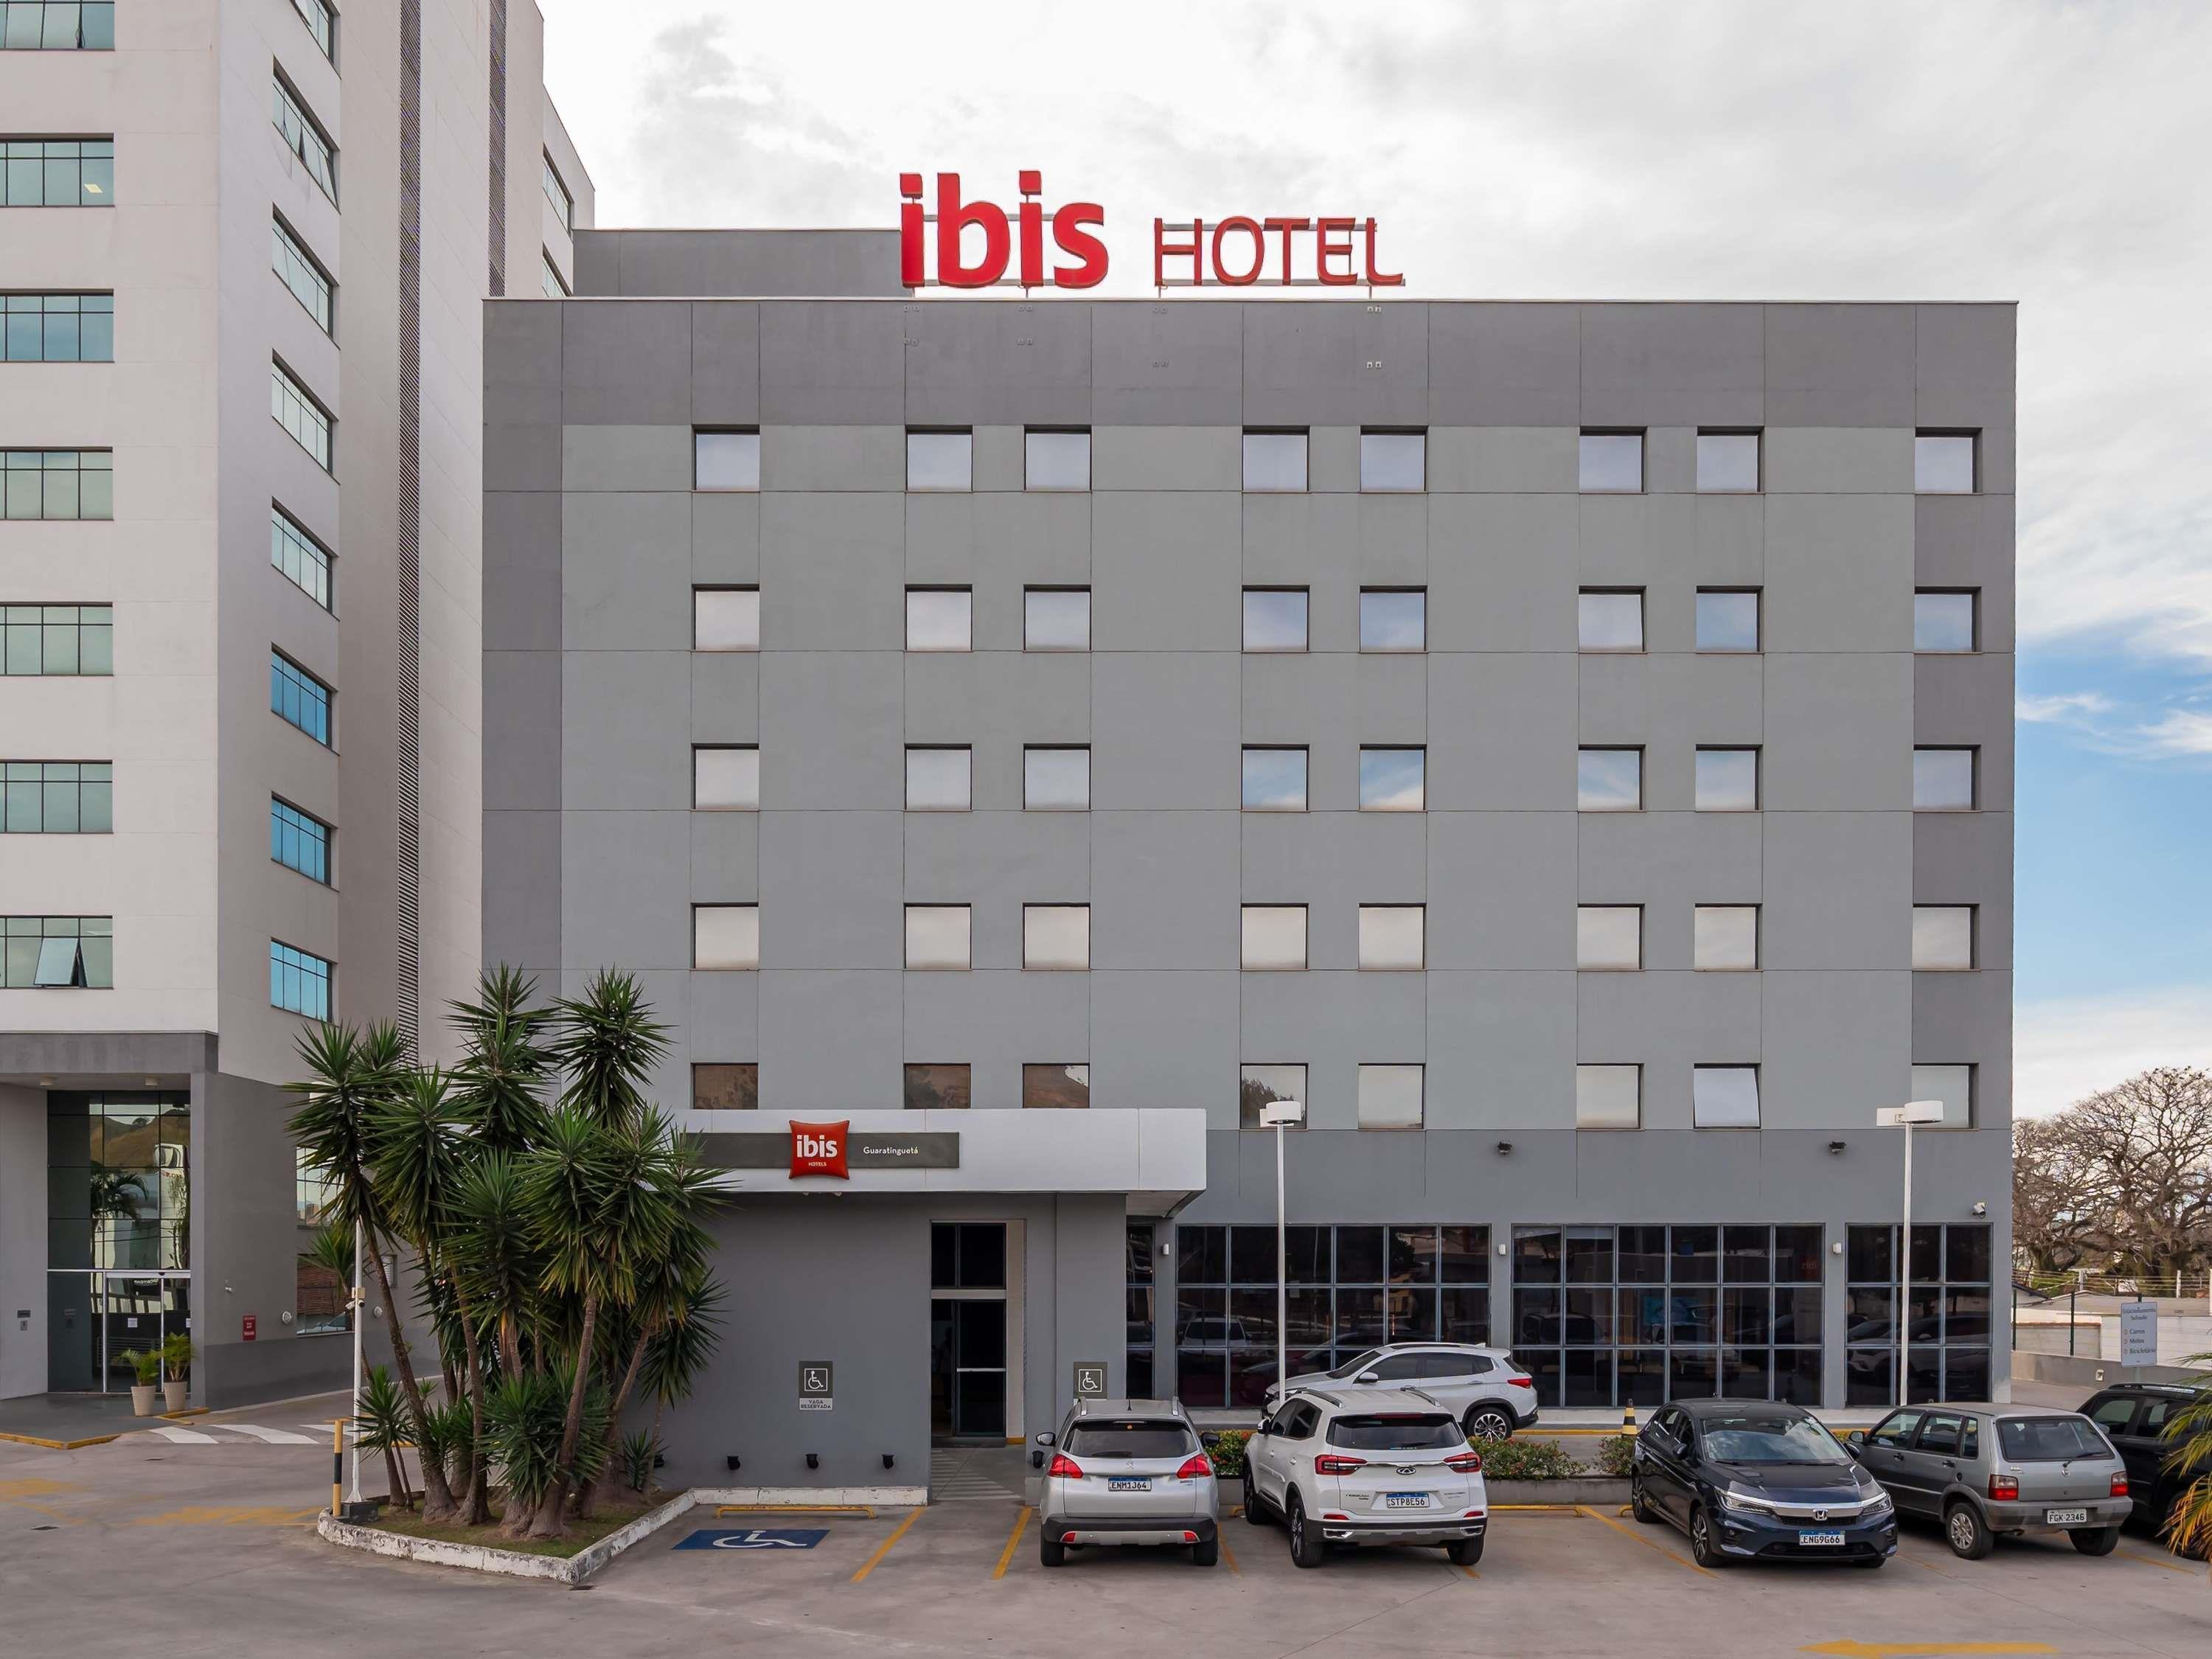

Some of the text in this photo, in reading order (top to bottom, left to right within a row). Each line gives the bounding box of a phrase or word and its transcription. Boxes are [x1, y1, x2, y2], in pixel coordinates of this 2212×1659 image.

[900, 170, 1404, 289] ibis HOTEL
[796, 1134, 838, 1158] ibis
[863, 1146, 919, 1156] Guaratinguetá
[1390, 1498, 1425, 1507] STP8E56
[1804, 1535, 1840, 1544] ENG9G66
